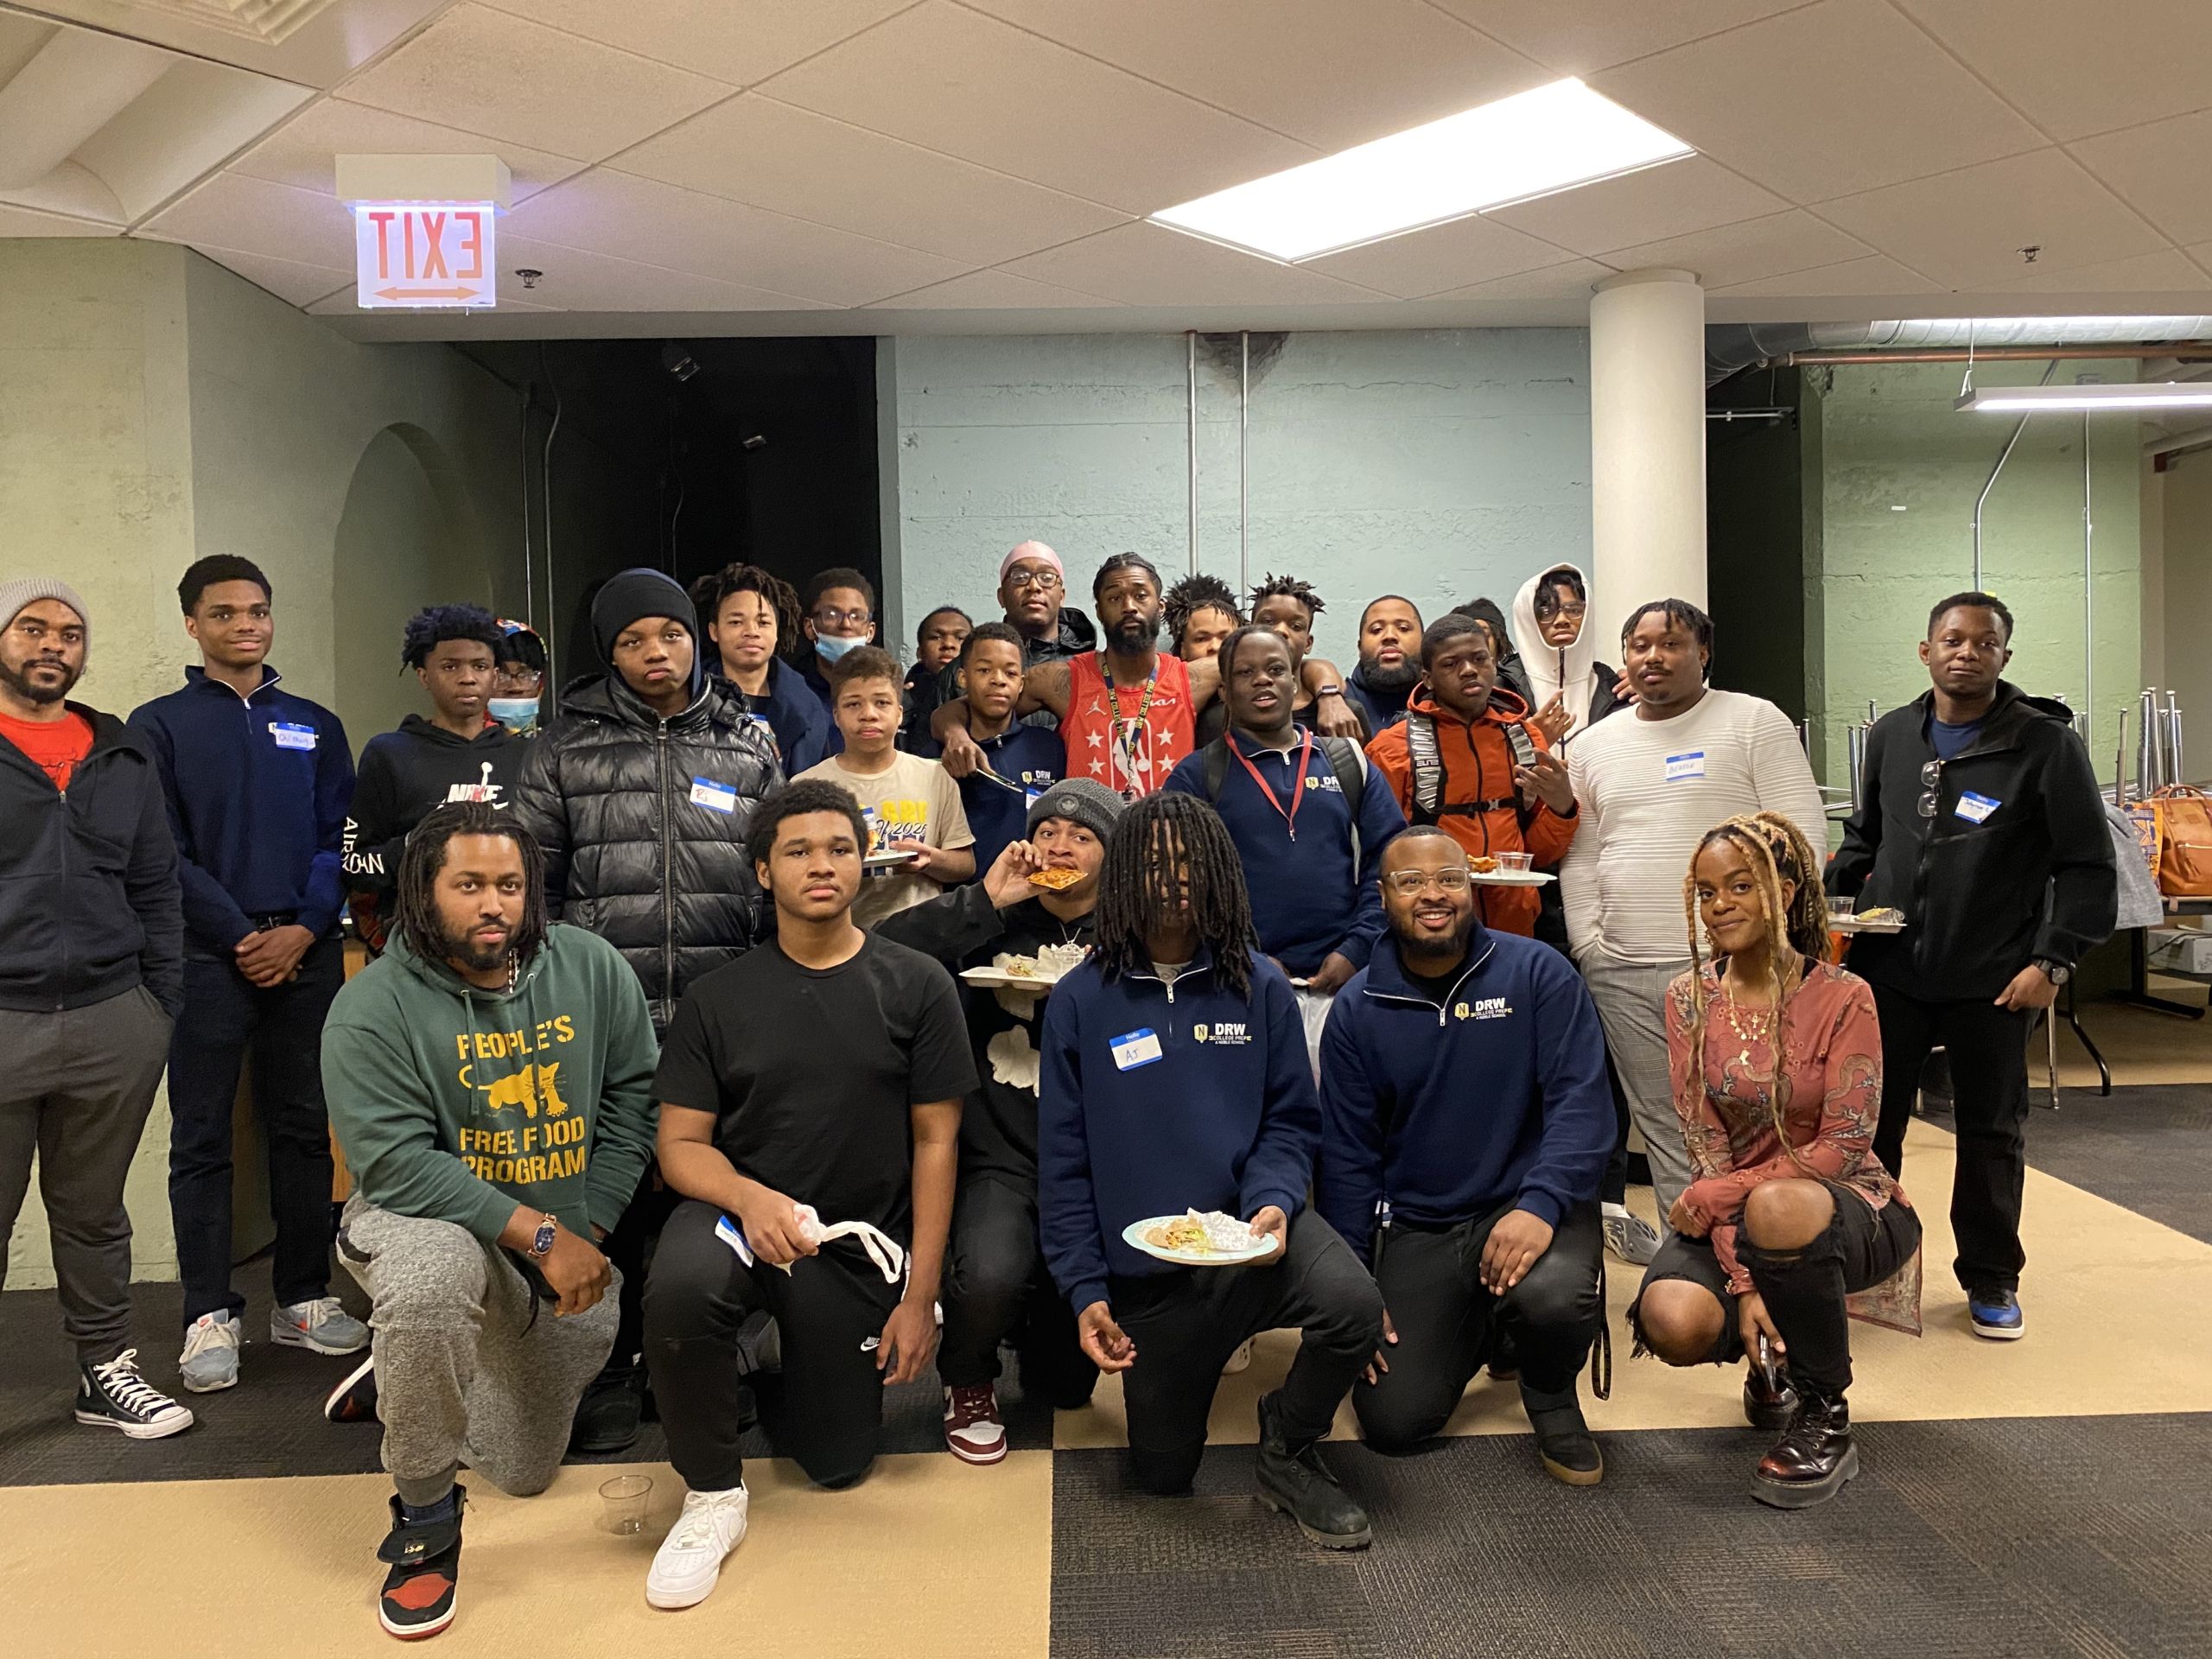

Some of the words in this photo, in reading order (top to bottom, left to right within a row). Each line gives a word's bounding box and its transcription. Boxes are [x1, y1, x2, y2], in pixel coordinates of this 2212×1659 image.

[1322, 775, 1340, 786] DR
[447, 783, 504, 803] NIKE
[1475, 997, 1506, 1012] DRW
[455, 1014, 575, 1060] PEOPLE'S
[1215, 1022, 1246, 1036] DRW
[460, 1127, 518, 1155] FREE
[461, 1145, 586, 1185] PROGRAM
